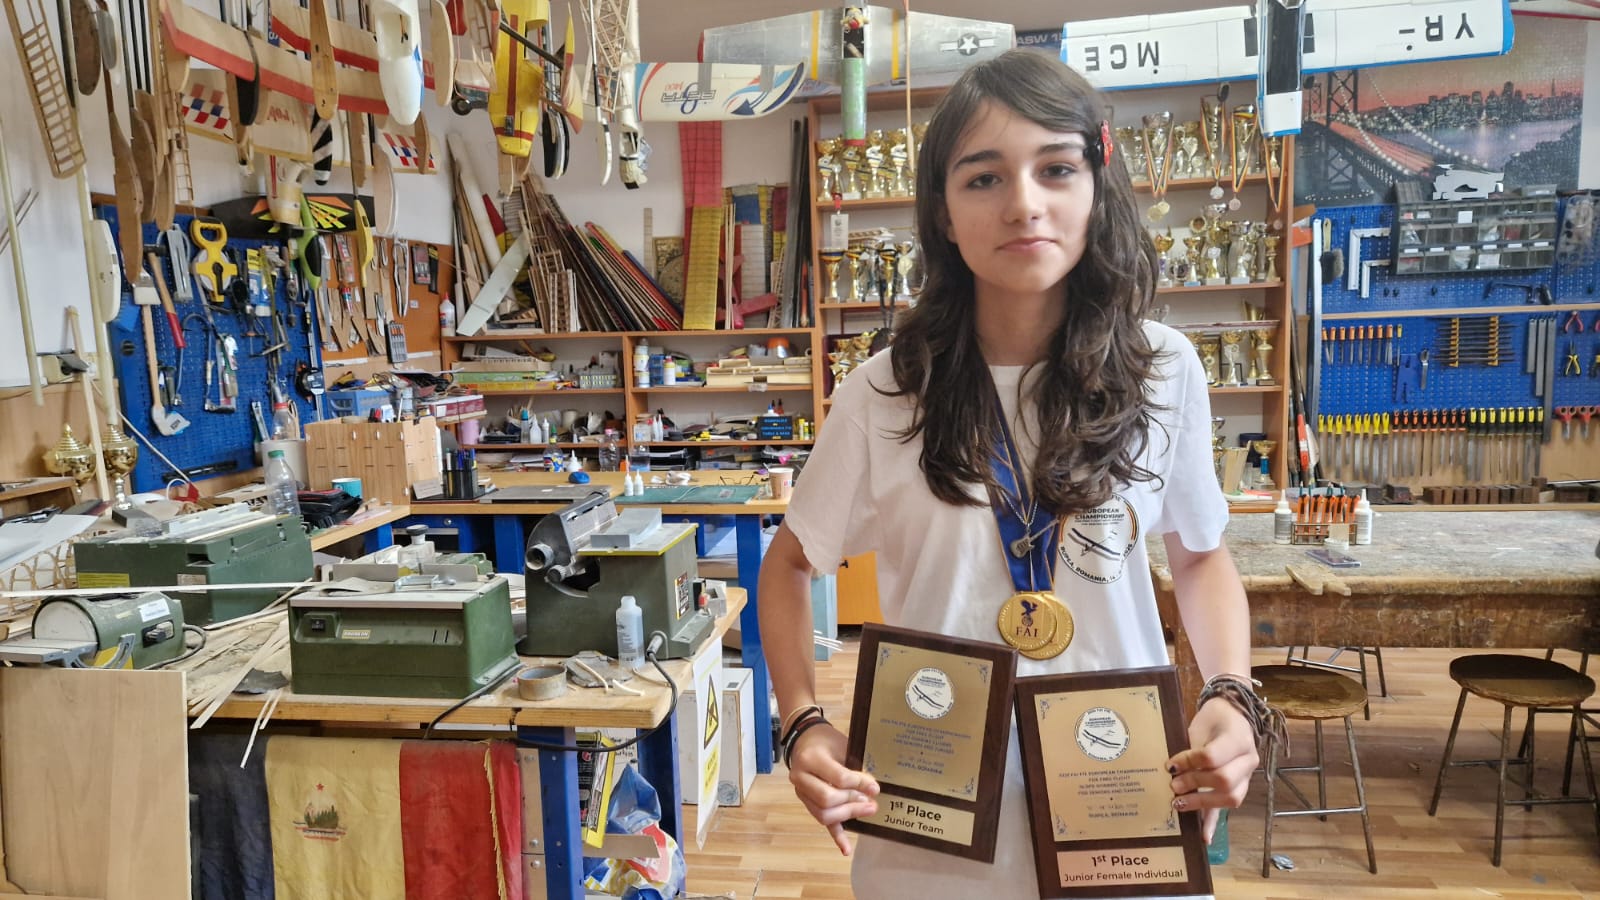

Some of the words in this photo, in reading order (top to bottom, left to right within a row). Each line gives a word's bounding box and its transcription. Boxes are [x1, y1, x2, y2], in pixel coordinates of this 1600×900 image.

[1399, 12, 1475, 42] YR-
[1084, 41, 1160, 72] MCE
[1016, 626, 1038, 638] FAI
[890, 800, 903, 811] 1st
[906, 804, 942, 821] Place
[884, 815, 915, 828] Junior
[918, 821, 944, 835] Team
[1091, 854, 1106, 867] 1st
[1111, 855, 1149, 866] Place
[1064, 873, 1094, 882] Junior
[1096, 870, 1132, 880] Female
[1134, 869, 1183, 879] Individual
